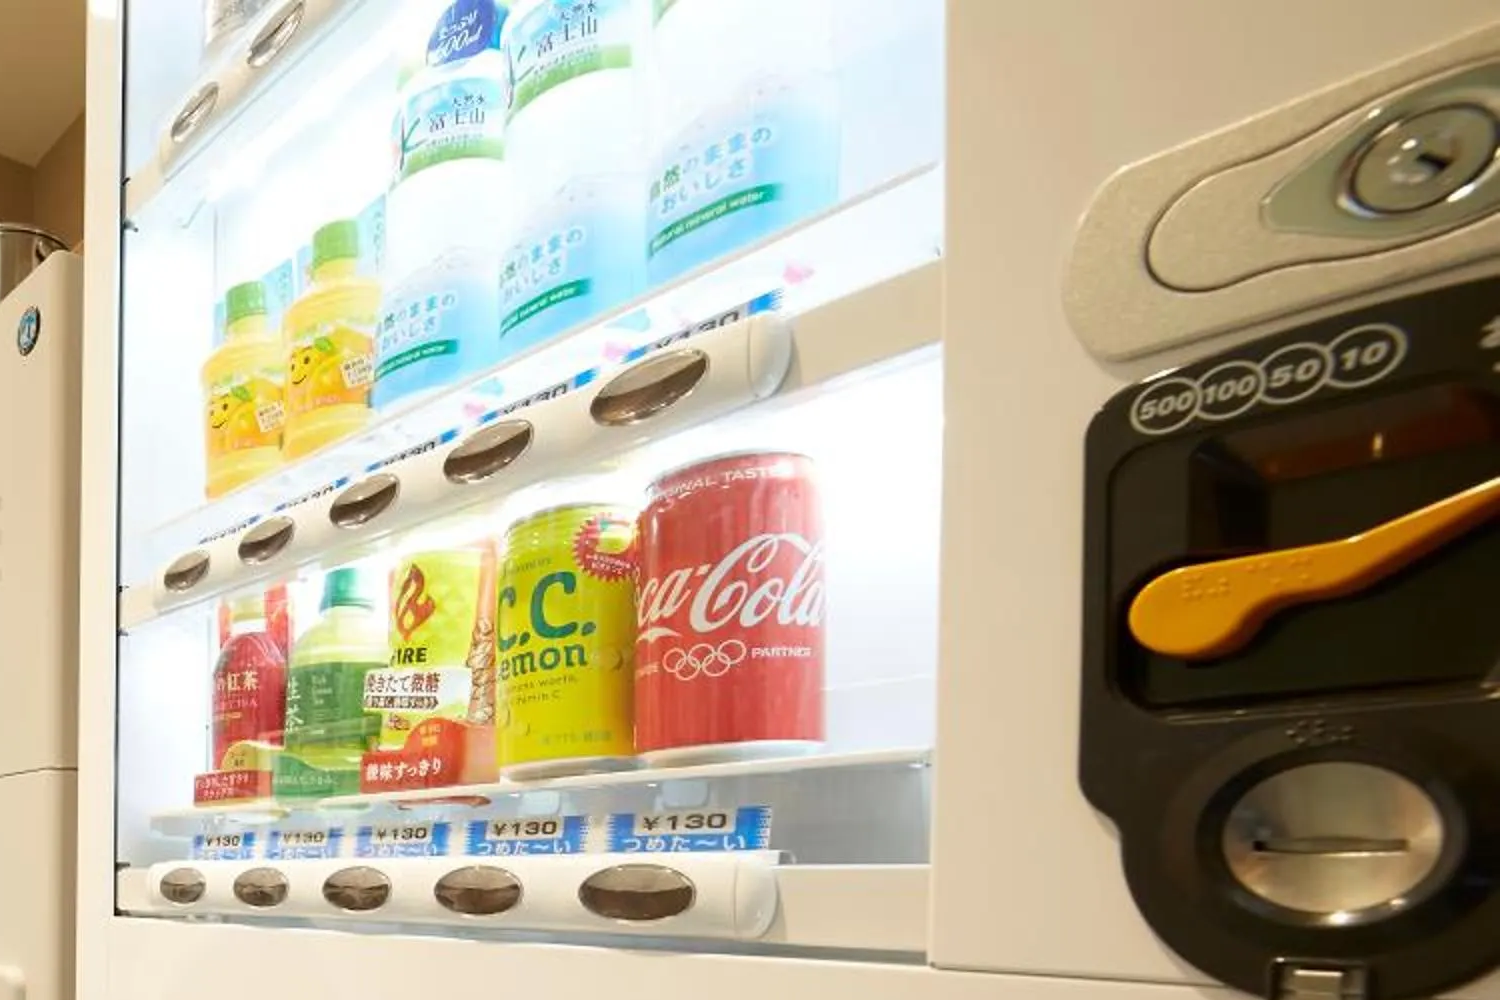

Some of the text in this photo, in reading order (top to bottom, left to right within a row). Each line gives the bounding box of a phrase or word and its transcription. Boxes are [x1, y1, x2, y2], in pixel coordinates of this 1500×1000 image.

[1137, 340, 1390, 421] 500 100 50 10
[500, 642, 588, 681] emon
[492, 819, 558, 837] ¥130
[642, 812, 729, 831] ¥130
[376, 826, 428, 841] ¥130
